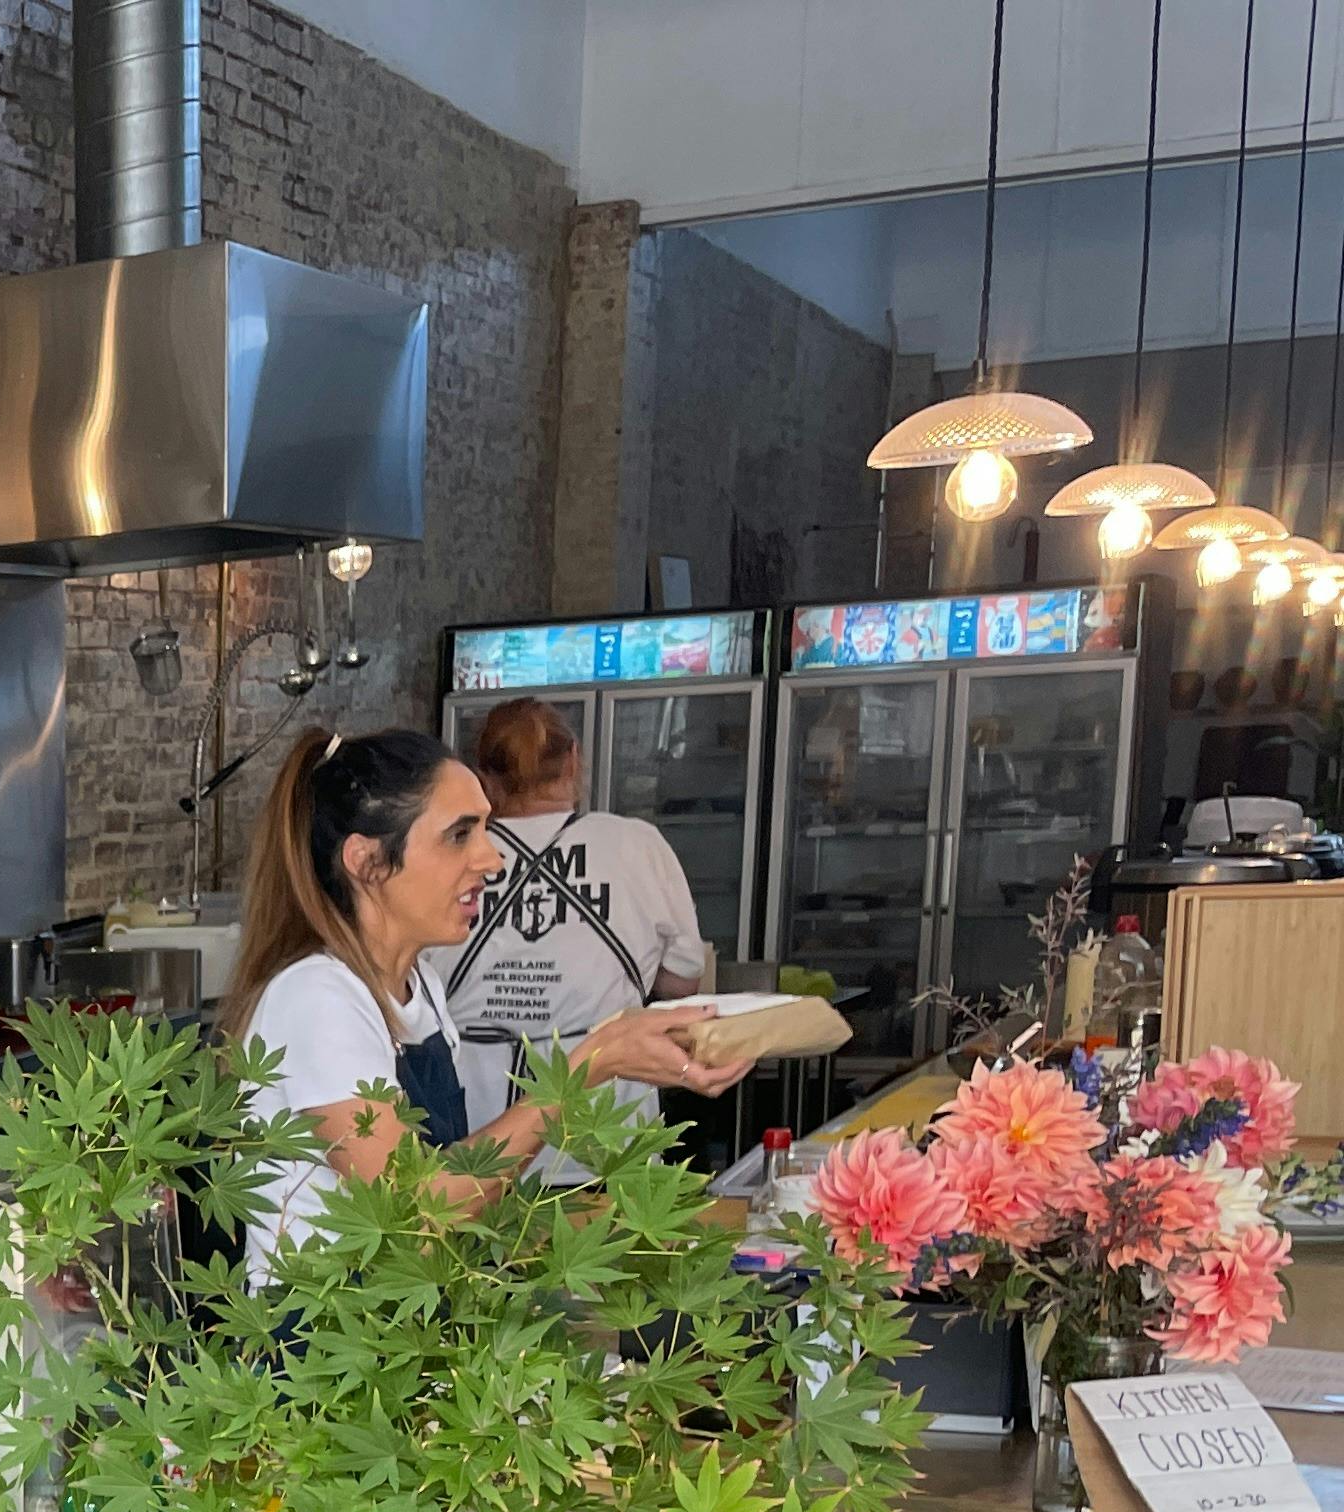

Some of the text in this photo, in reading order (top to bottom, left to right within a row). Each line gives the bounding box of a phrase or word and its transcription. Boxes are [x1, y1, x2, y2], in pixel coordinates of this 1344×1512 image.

[493, 960, 556, 970] ADELAIDE
[482, 973, 562, 983] MELBOURNE
[495, 985, 546, 996] SYDNEY
[486, 998, 550, 1009] BRISBANE
[480, 1011, 551, 1021] AUCKLAND
[1108, 1382, 1230, 1419] KITCHEN
[1138, 1426, 1269, 1472] CLOSED!
